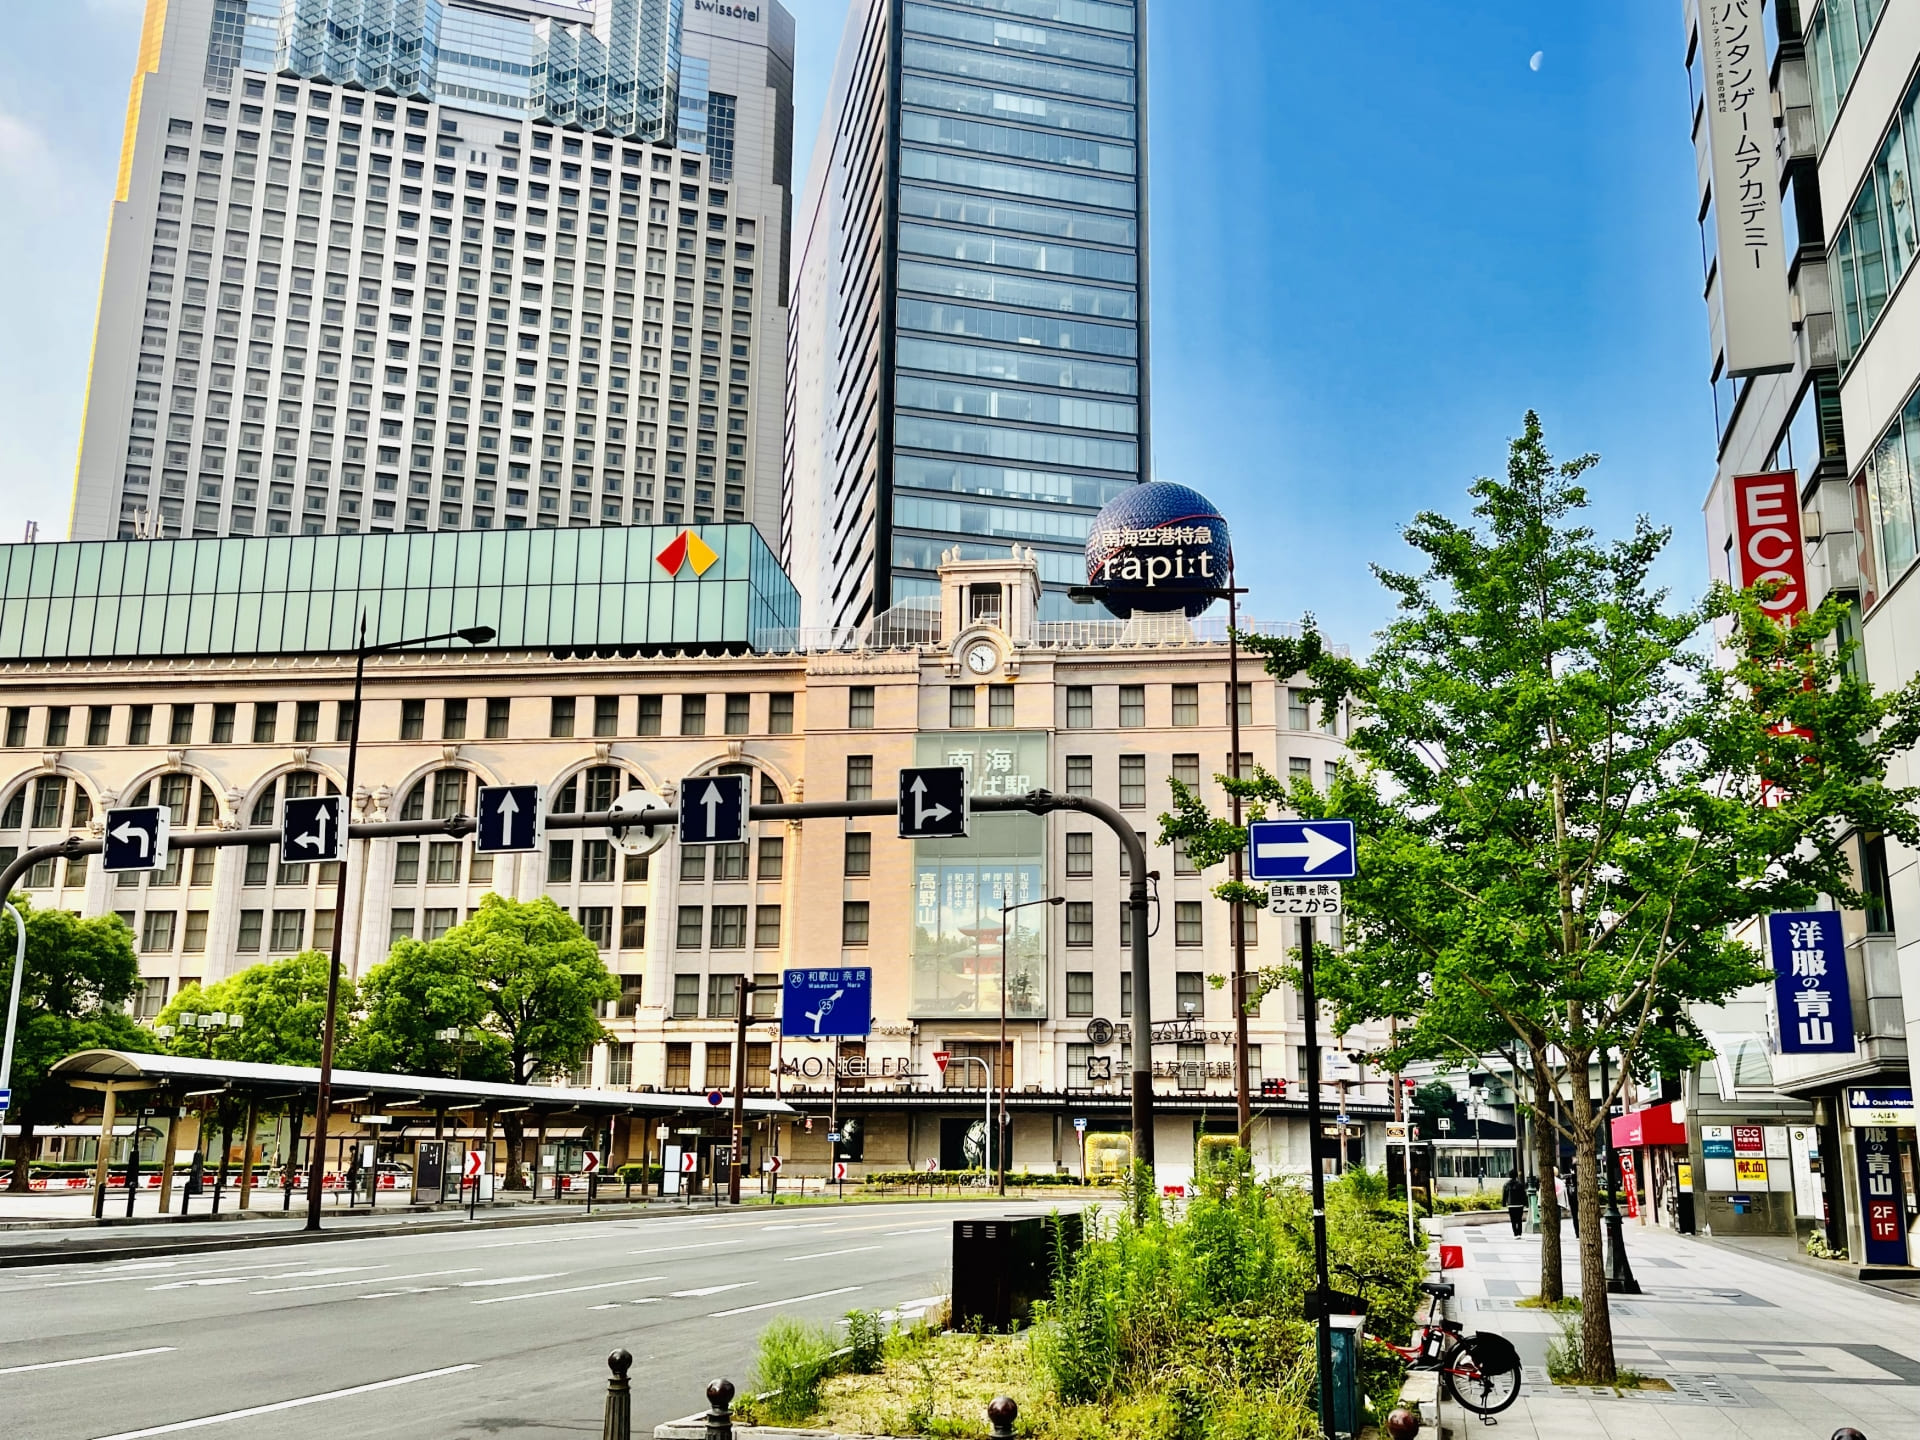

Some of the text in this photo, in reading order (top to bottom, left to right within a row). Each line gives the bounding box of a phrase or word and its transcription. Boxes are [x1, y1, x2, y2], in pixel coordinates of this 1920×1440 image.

[1721, 0, 1768, 269] バンタンゲームアカデミー
[1101, 525, 1213, 548] 南海空港特急
[1271, 884, 1338, 897] 自転車を除く
[919, 872, 937, 924] 高野山
[1272, 898, 1338, 914] ここから
[791, 974, 802, 983] 26
[808, 970, 866, 982] 和歌山 奈良
[1788, 920, 1834, 1045] 洋服の青山
[821, 1001, 832, 1010] 25
[1736, 1128, 1760, 1137] ECC
[1737, 1160, 1765, 1173] 献血
[1873, 1206, 1893, 1218] 2F
[1876, 1223, 1895, 1235] 1F
